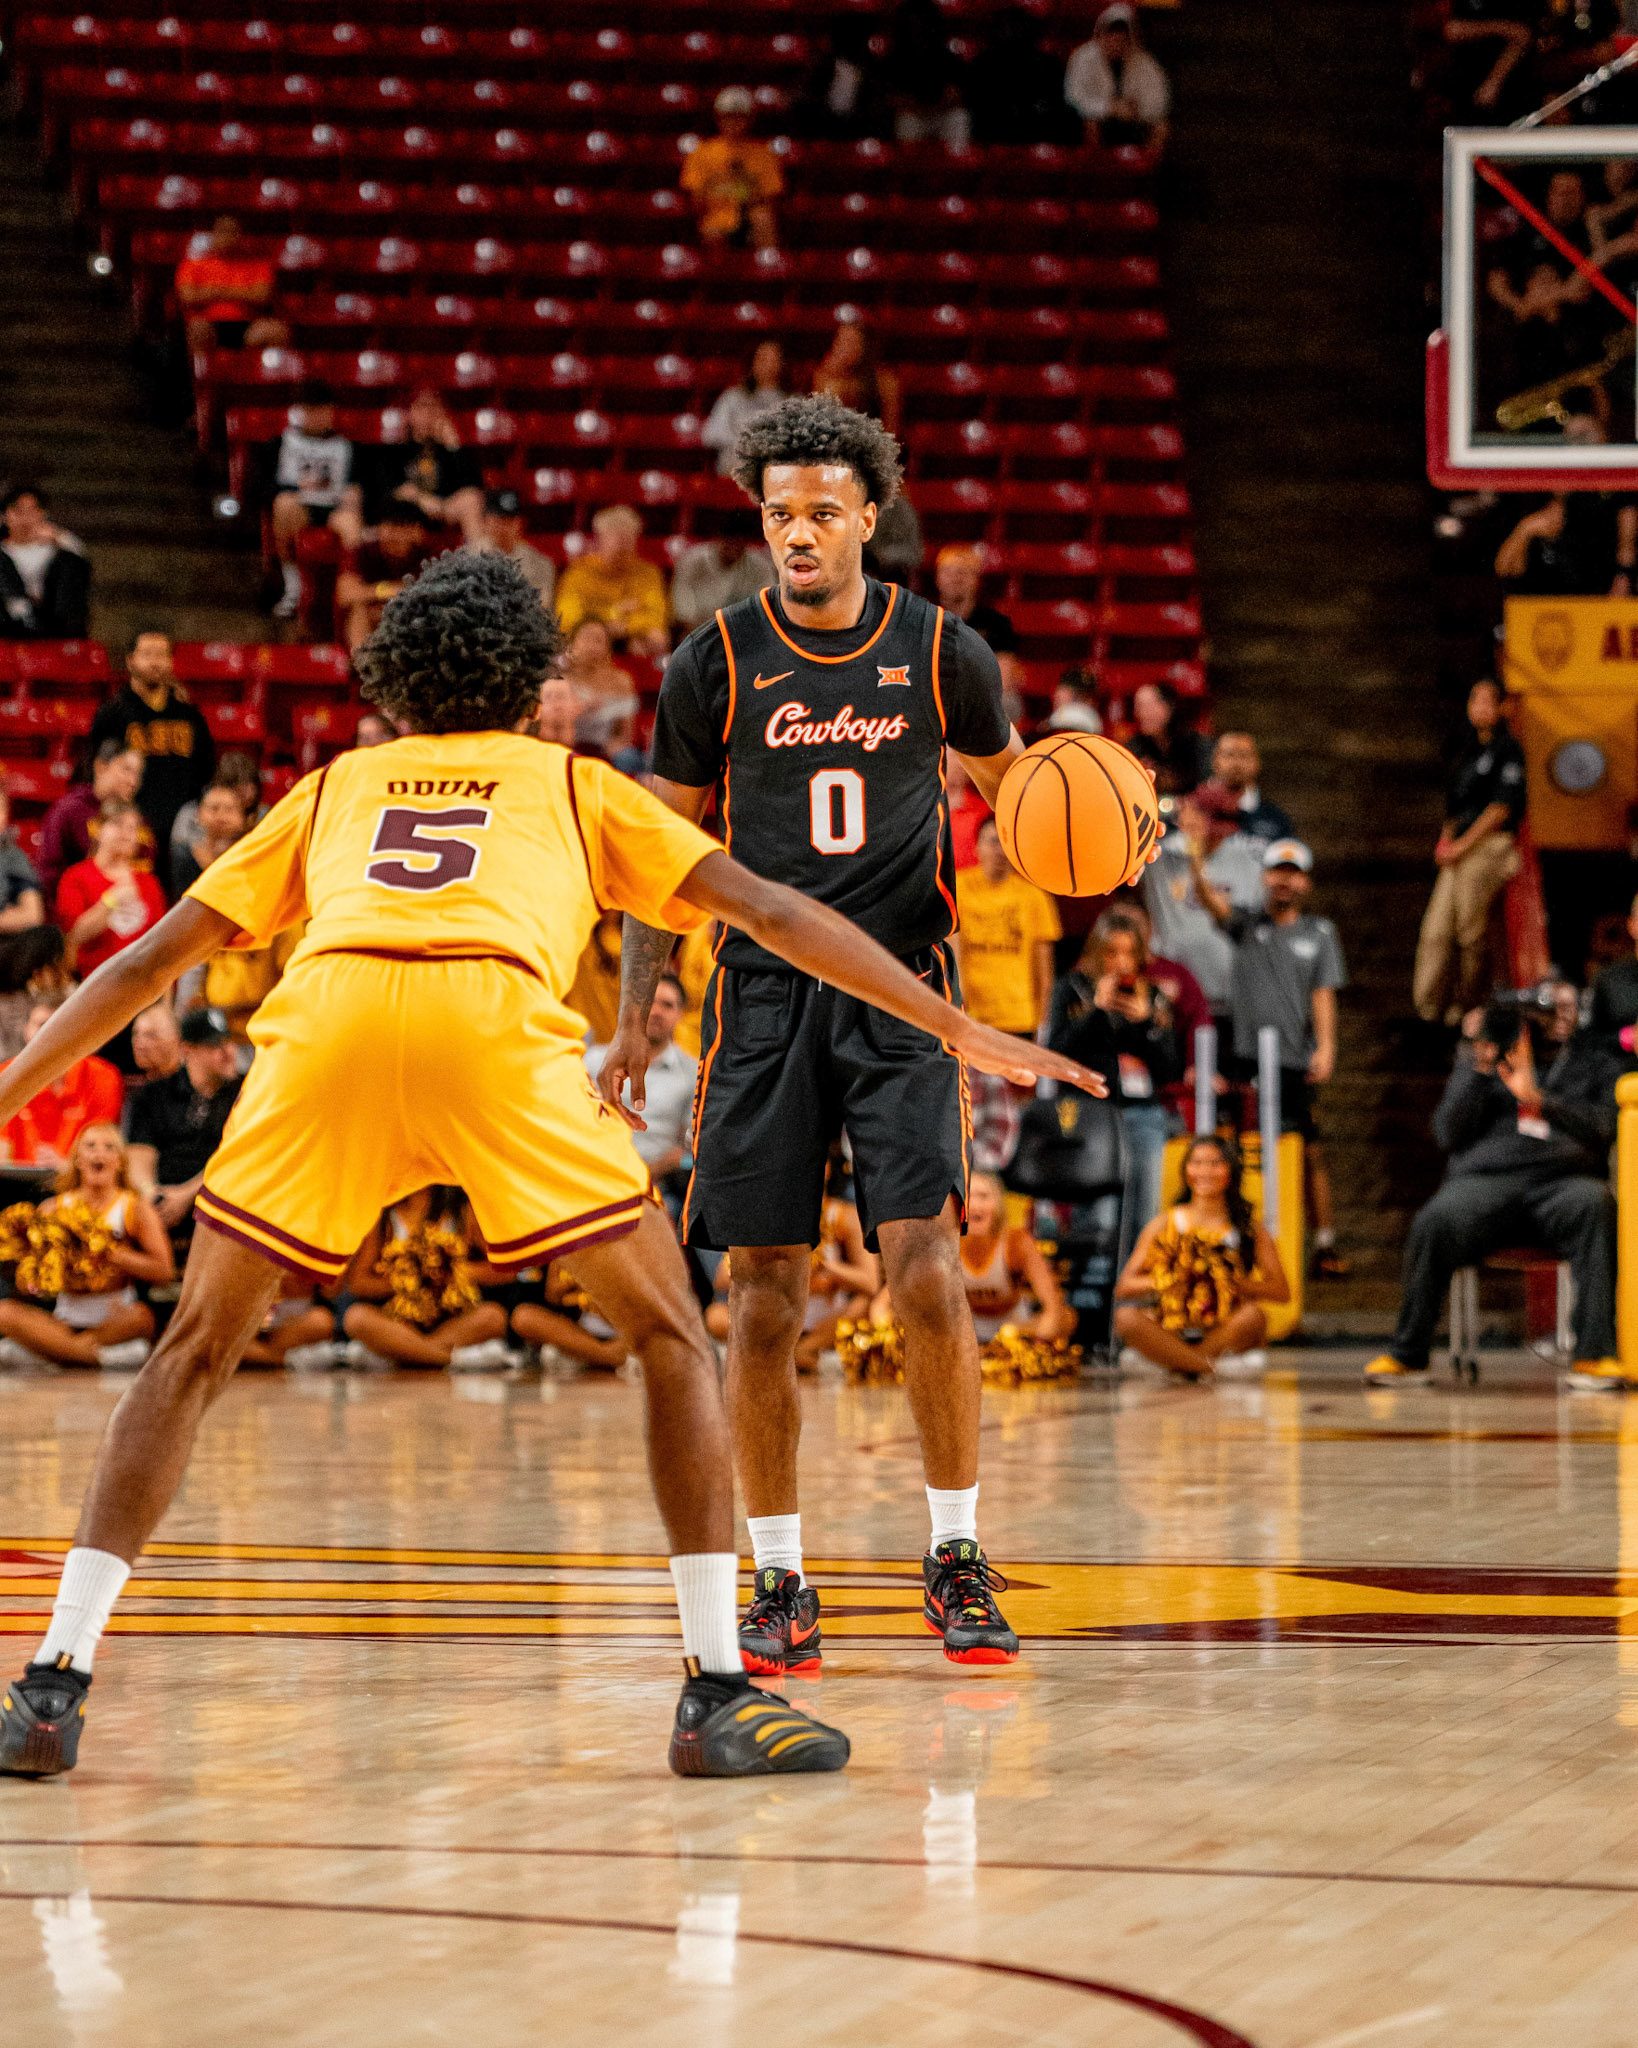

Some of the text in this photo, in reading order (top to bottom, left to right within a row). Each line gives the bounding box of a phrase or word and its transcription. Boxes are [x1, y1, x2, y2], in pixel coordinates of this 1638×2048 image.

[765, 701, 910, 752] Cowboys
[387, 780, 500, 801] ODUM
[809, 768, 867, 856] 0
[363, 806, 493, 893] 5
